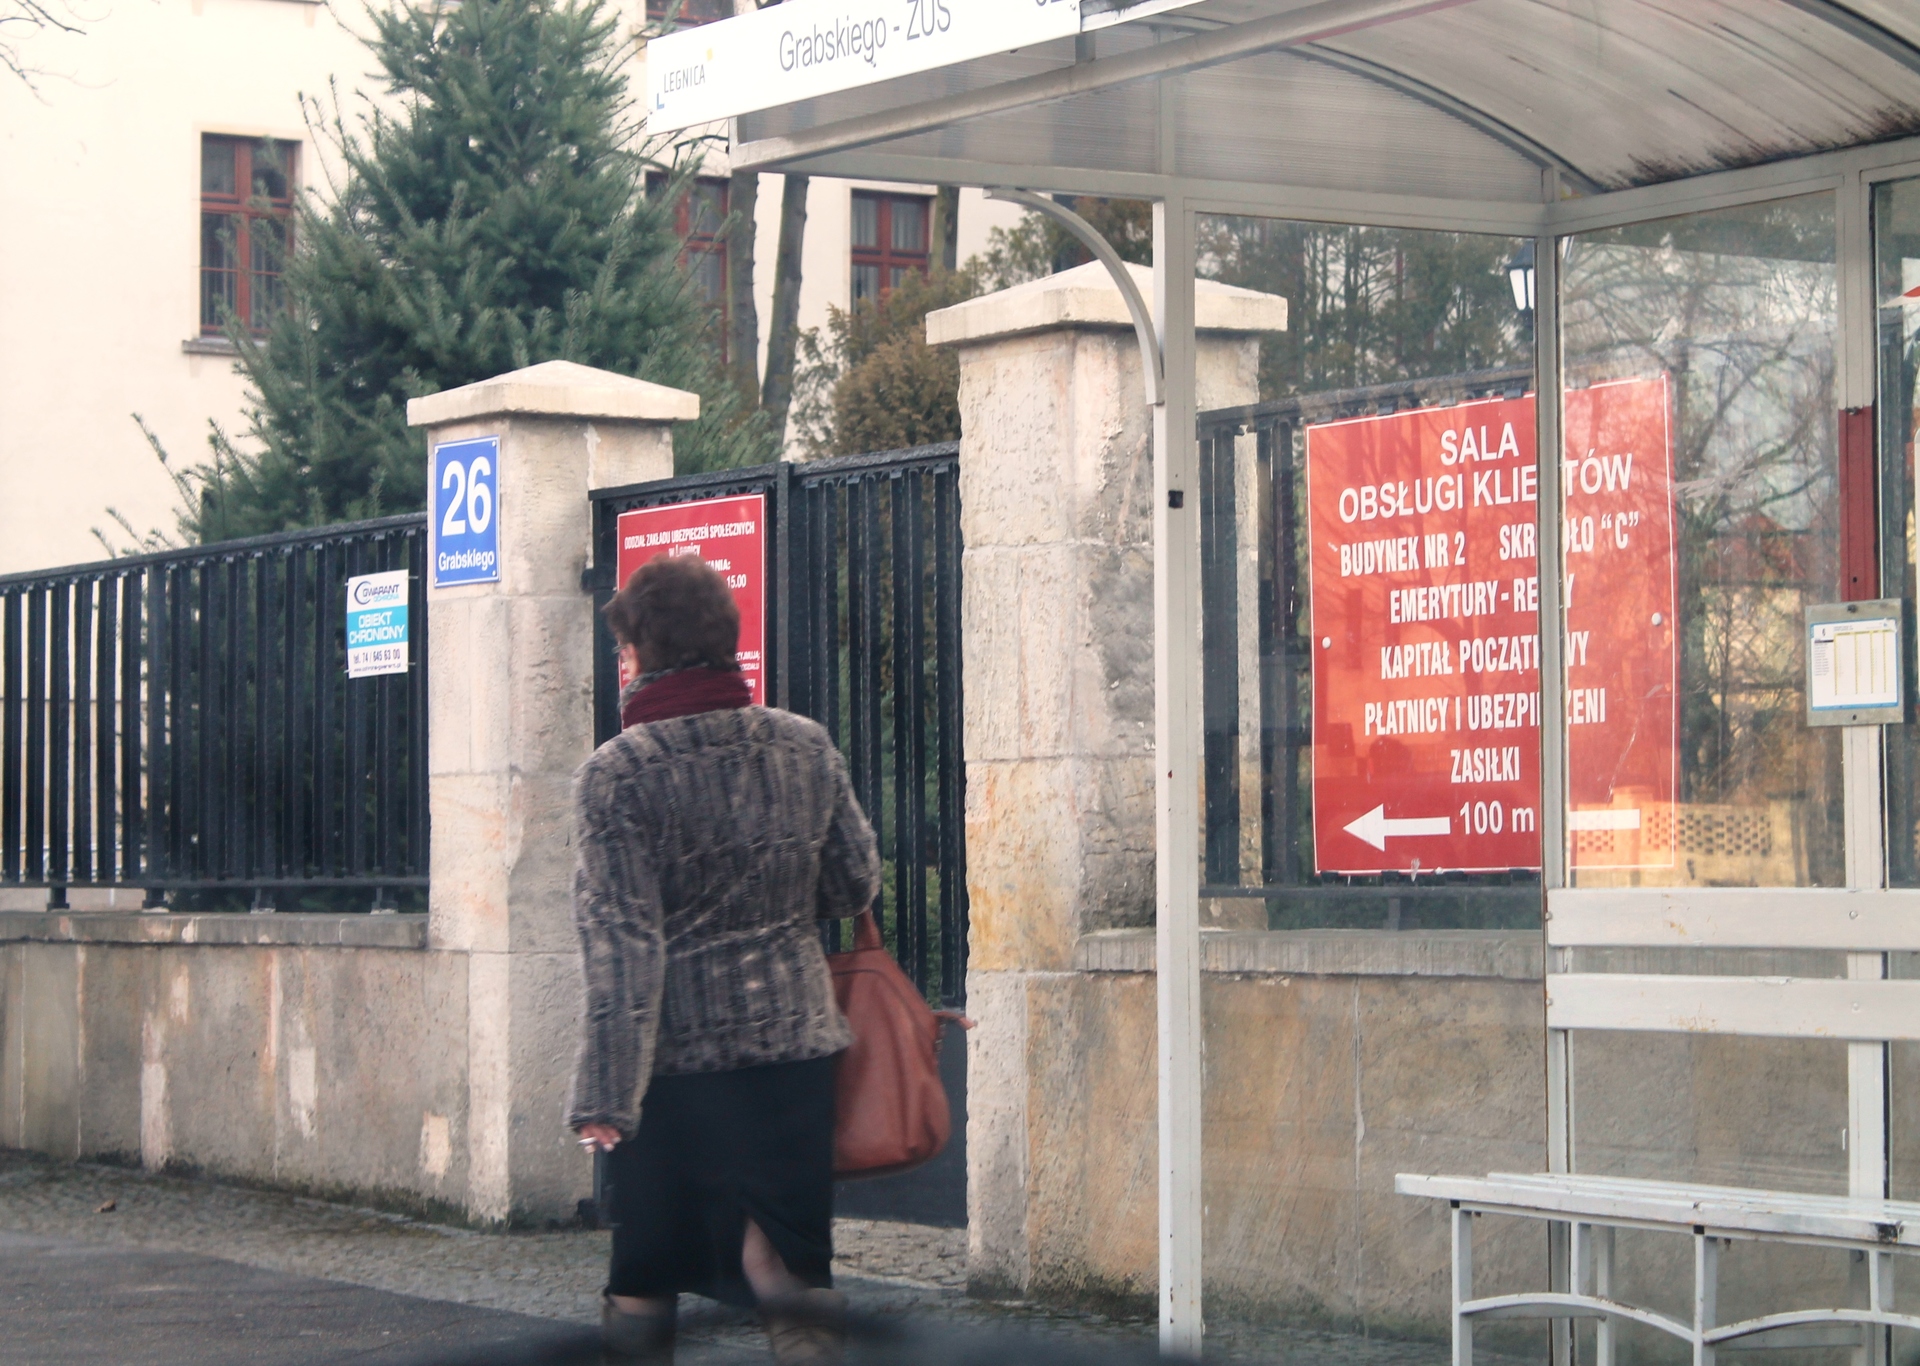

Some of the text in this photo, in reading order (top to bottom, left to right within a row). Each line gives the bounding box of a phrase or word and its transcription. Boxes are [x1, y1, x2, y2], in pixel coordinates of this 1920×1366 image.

[779, 15, 887, 72] Grabskiego
[906, 0, 951, 41] ZUS
[663, 64, 706, 94] LEGNICA
[1440, 422, 1519, 466] SALA
[441, 456, 492, 537] 26
[1339, 448, 1633, 523] OBSŁUGI KLIETÓW
[624, 521, 755, 550] ODDZIAŁ ZAKŁADU UBEZPIECZEŃ SPOŁECZNYCH
[1340, 535, 1419, 577] BUDYNEK
[1424, 532, 1449, 569] NR
[1454, 531, 1466, 566] 2
[438, 548, 495, 572] Grabskiego
[363, 584, 400, 598] GWARANT
[726, 574, 747, 590] 15.00
[1390, 580, 1499, 624] EMERYTURY
[1513, 573, 1575, 613] REY
[349, 624, 406, 645] CHRONIONY
[358, 611, 393, 629] OBIEKT
[1381, 641, 1453, 680] KAPITAŁ
[1365, 696, 1449, 736] PŁATNICY
[1455, 696, 1461, 731] I
[1451, 746, 1520, 784] ZASIŁKI
[1459, 800, 1534, 835] 100 m
